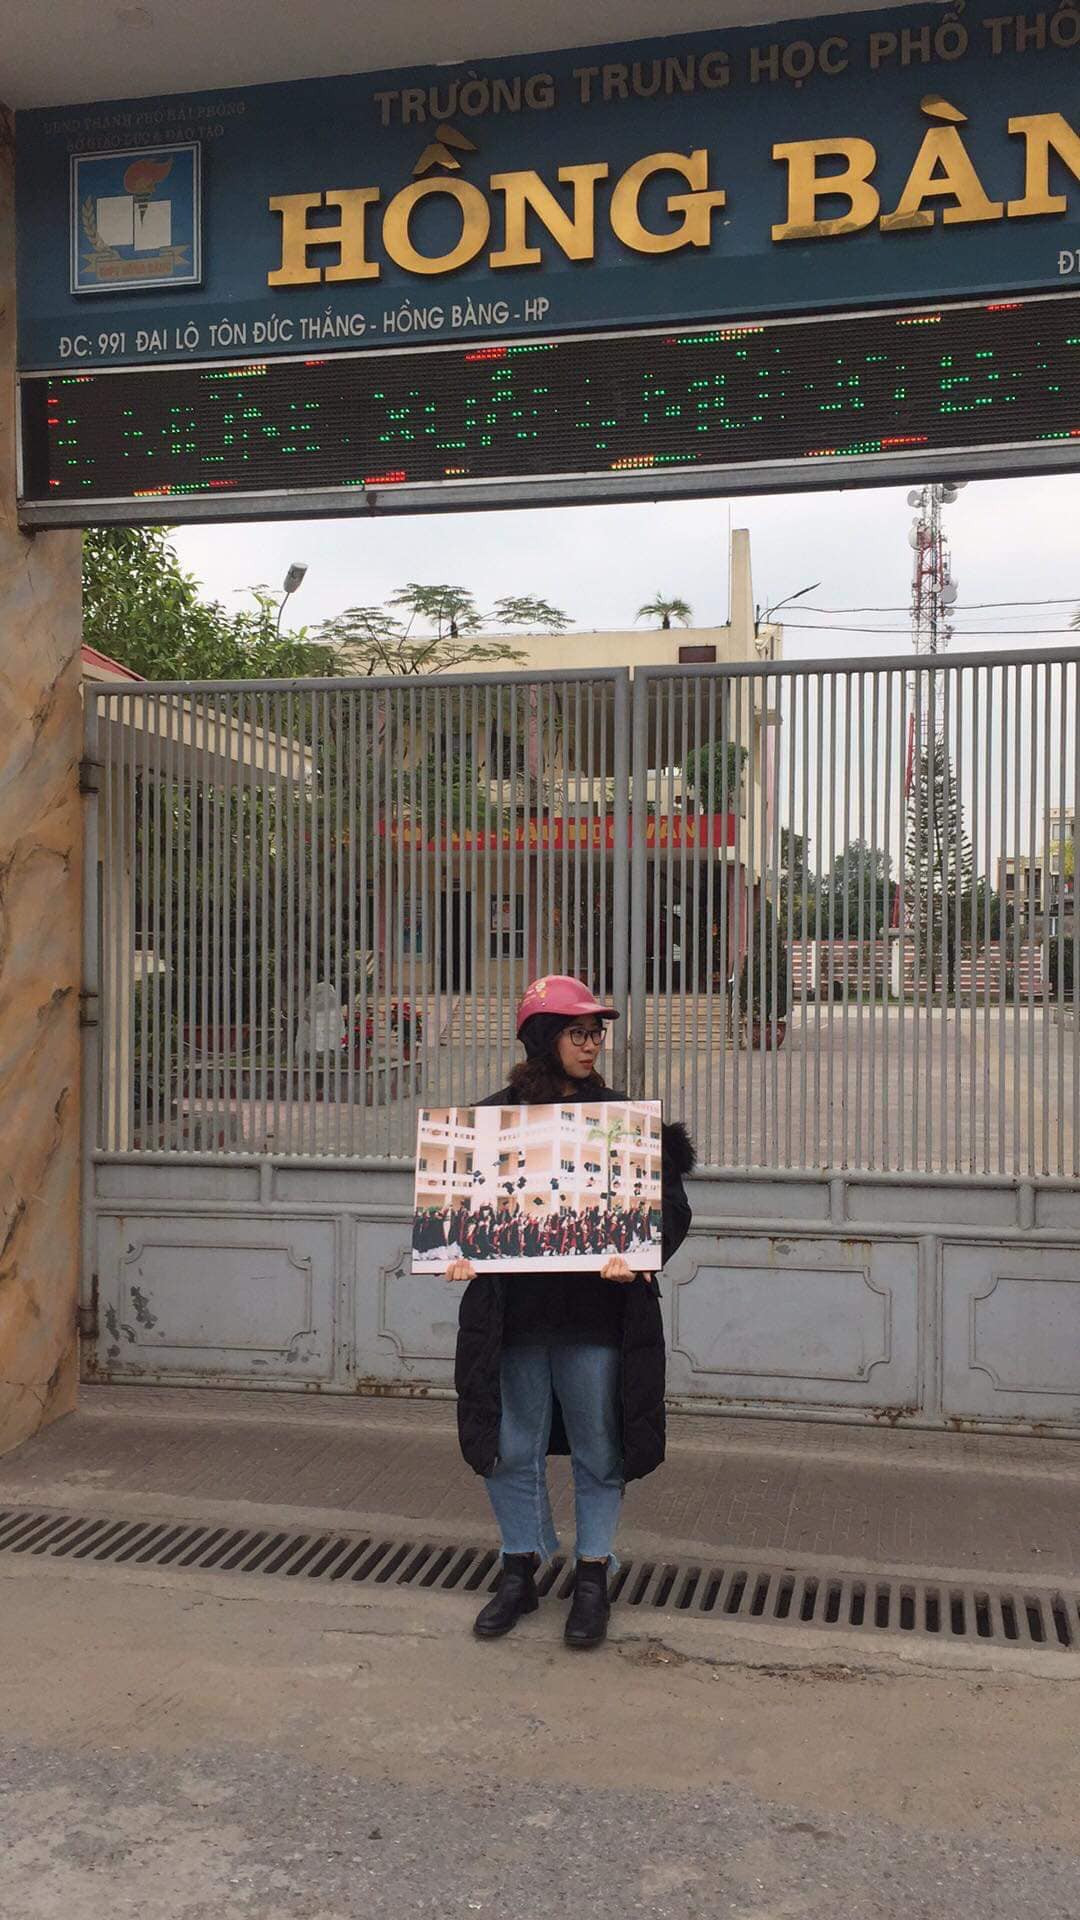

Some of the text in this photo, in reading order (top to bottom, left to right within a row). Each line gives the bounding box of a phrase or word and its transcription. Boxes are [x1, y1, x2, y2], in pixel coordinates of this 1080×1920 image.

[373, 70, 555, 127] TRƯỜNG
[573, 51, 730, 104] TRUNG
[750, 37, 849, 88] HỌC
[869, 0, 969, 70] PHỔ
[267, 124, 726, 288] HỒNG
[58, 334, 93, 358] ĐC:
[98, 331, 125, 354] 991
[136, 329, 168, 354] ĐẠI
[175, 320, 200, 352] LỘ
[209, 318, 247, 346] TÔN
[253, 313, 294, 343] ĐỨC
[300, 305, 366, 340] THẮNG
[383, 298, 445, 334] HỒNG
[451, 297, 509, 328] BÀNG
[524, 297, 551, 322] HP
